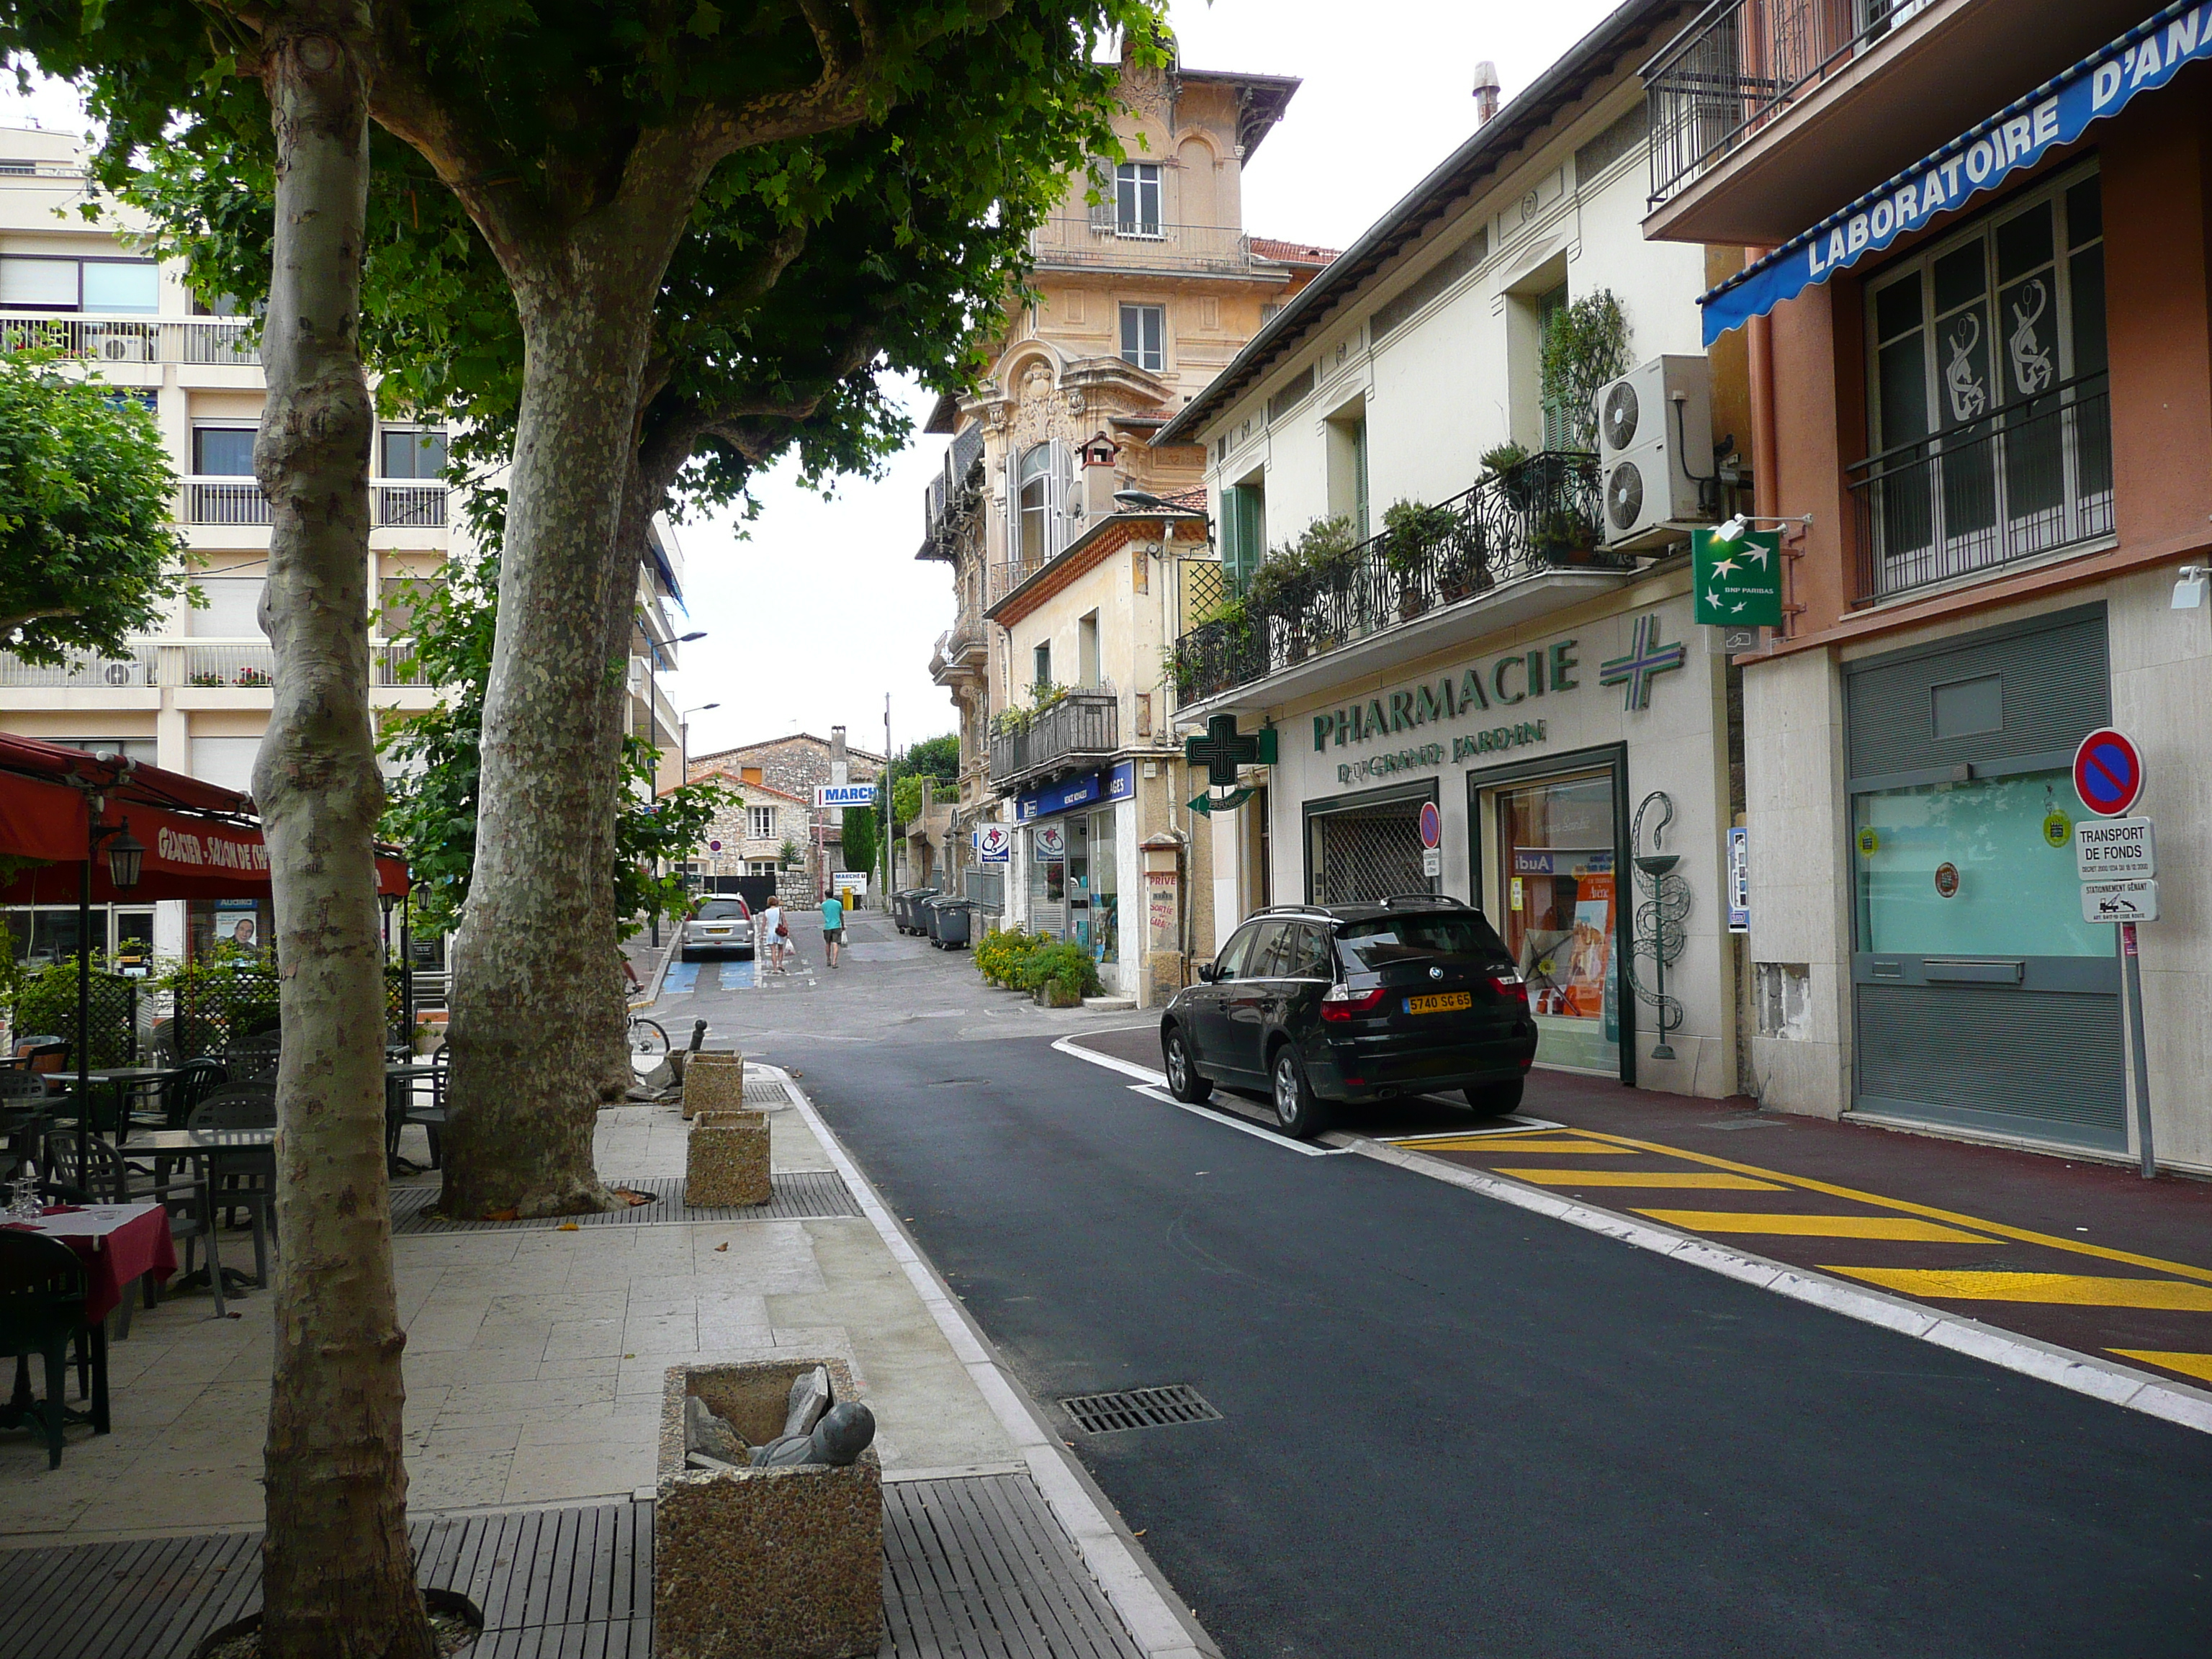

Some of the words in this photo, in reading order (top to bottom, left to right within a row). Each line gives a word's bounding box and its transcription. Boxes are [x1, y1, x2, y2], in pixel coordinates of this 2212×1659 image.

[1808, 94, 2059, 276] LABORATOIRE
[1313, 639, 1578, 751] PHARMACIE
[1337, 763, 1368, 783] DU
[1368, 742, 1444, 776] GRAND
[1451, 719, 1547, 764] JARDIN
[1210, 793, 1243, 809] PARKING
[2080, 827, 2145, 843] TRANSPORT
[158, 827, 203, 865] GLACIER
[207, 836, 239, 869] SALON
[237, 843, 252, 870] DE
[2085, 848, 2100, 860] DE
[2103, 845, 2142, 859] FONDS
[2086, 884, 2126, 894] STATIONNEMENT
[2127, 882, 2147, 891] GÊNANT
[1150, 904, 1174, 915] SORTIE
[1410, 997, 1438, 1010] 5740
[1441, 995, 1455, 1007] SG
[1457, 994, 1470, 1005] 65
